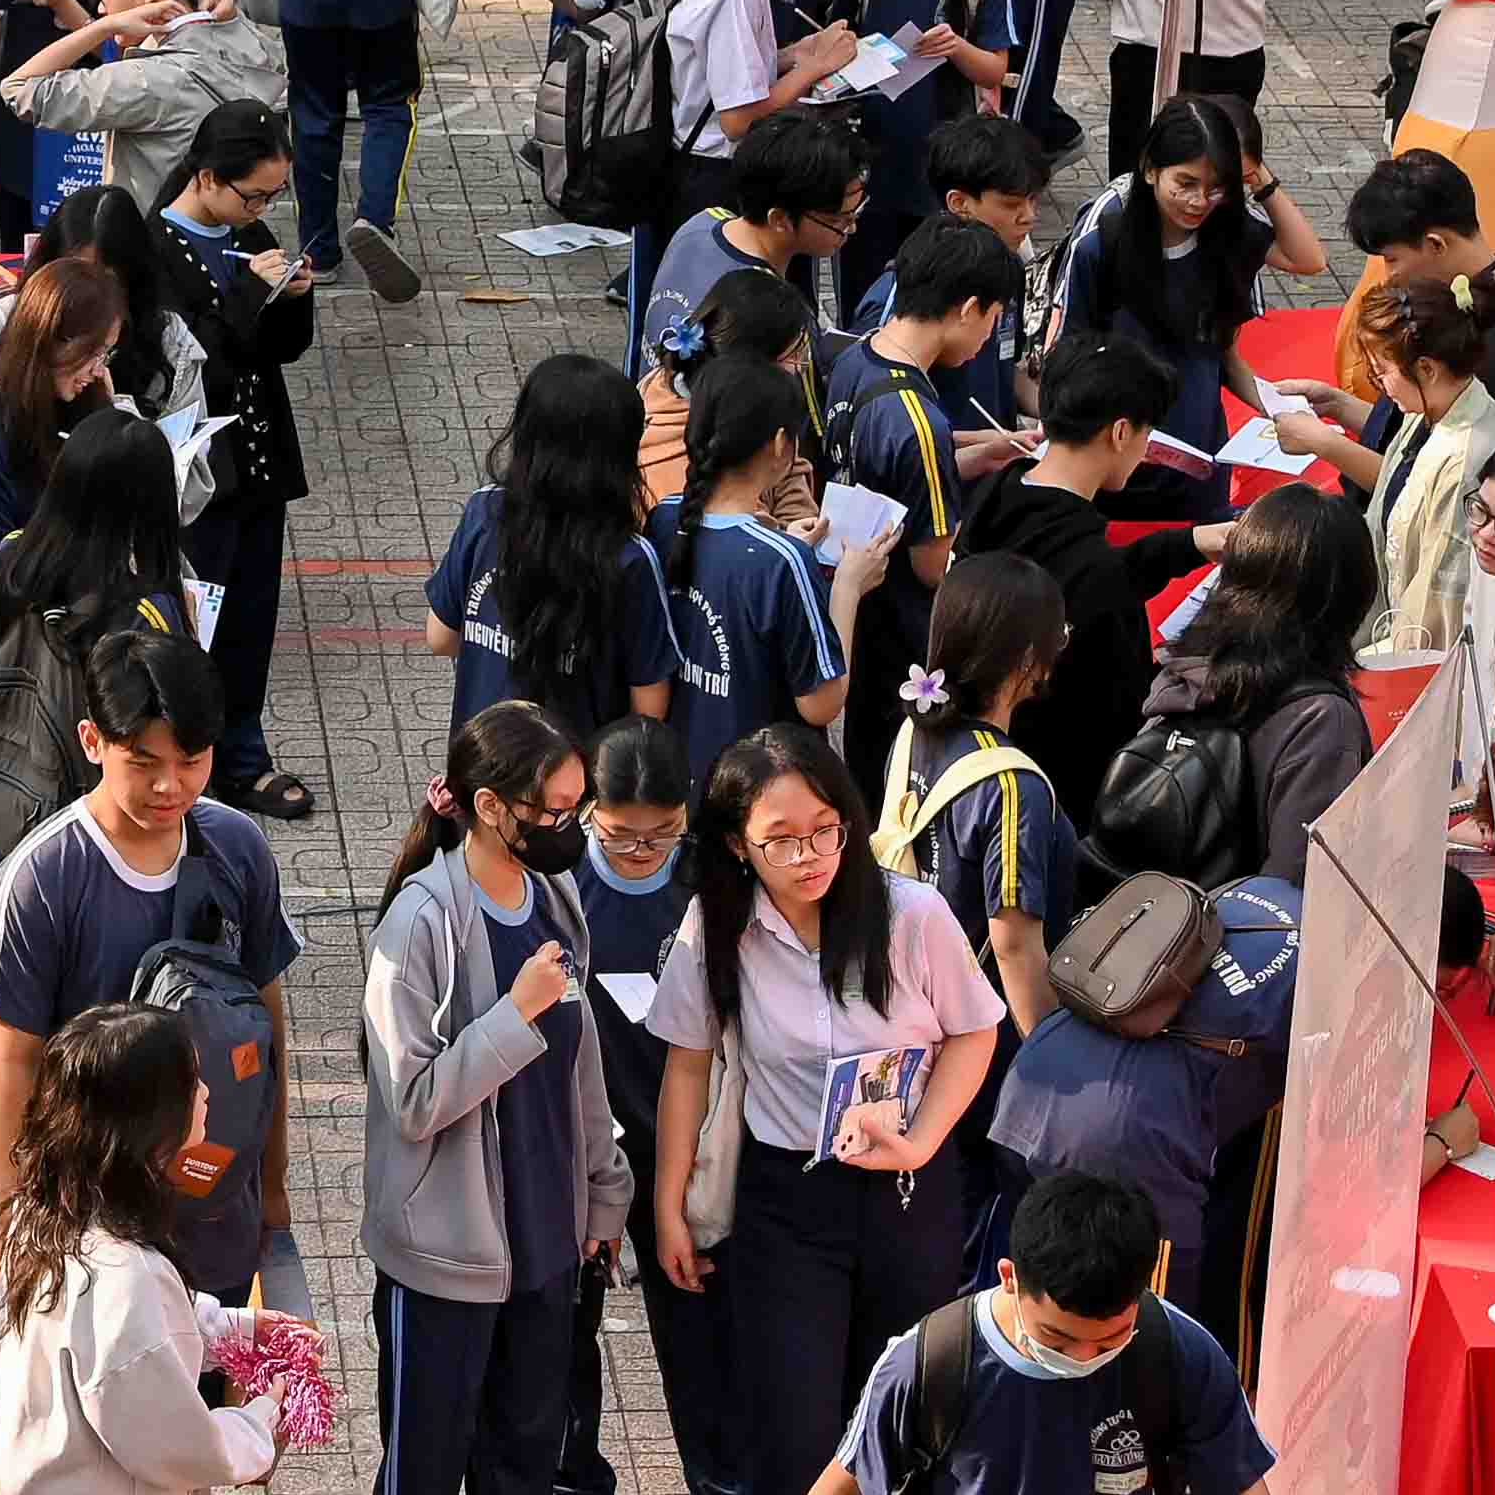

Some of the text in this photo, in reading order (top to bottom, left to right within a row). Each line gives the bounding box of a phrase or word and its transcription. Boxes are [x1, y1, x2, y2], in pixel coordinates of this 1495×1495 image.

[63, 154, 103, 166] UNIVERS
[467, 571, 493, 616] TRƯỜNG
[465, 619, 509, 658] NGUYỄN
[712, 625, 731, 672] THÔNG
[704, 670, 731, 698] TRỨ
[1238, 890, 1279, 912] TRUNG
[1219, 961, 1256, 997] TRỨ
[1255, 947, 1293, 983] THÔNG
